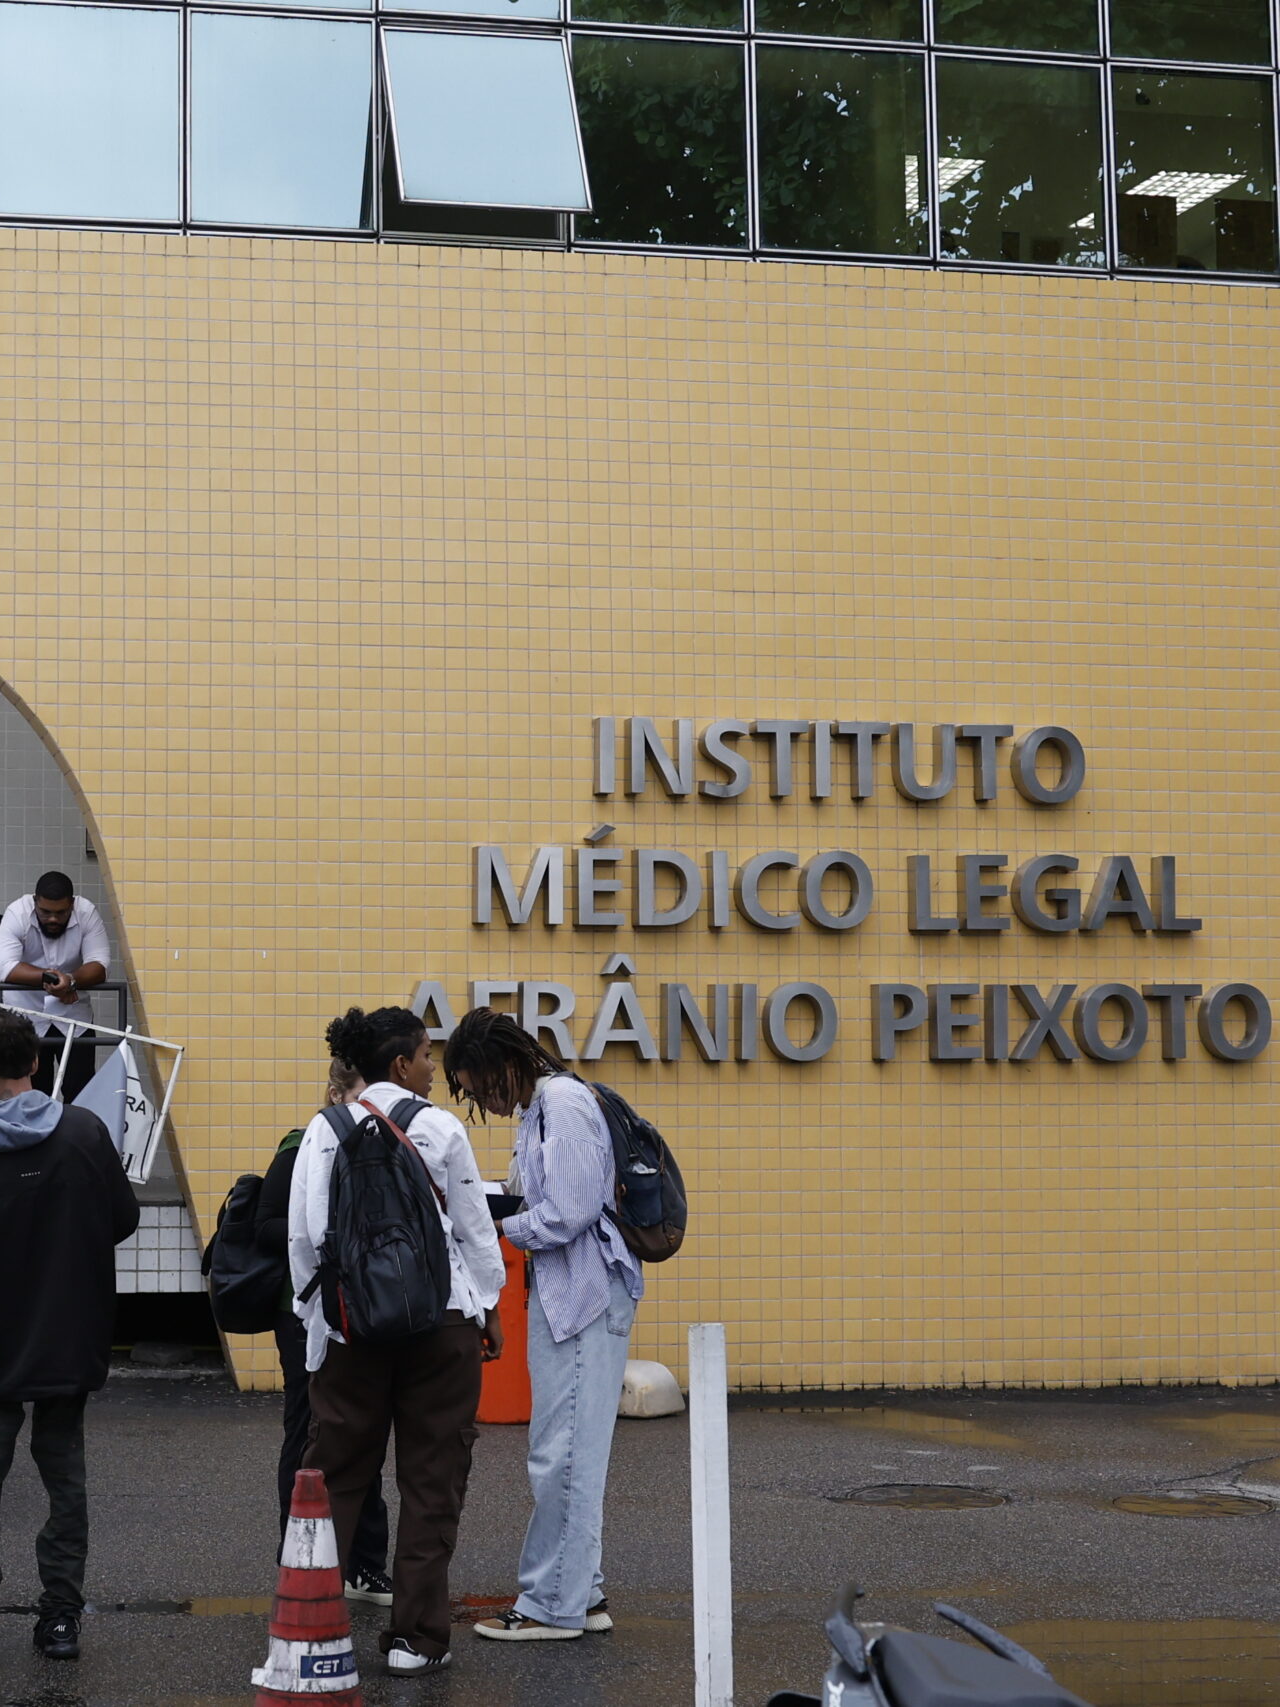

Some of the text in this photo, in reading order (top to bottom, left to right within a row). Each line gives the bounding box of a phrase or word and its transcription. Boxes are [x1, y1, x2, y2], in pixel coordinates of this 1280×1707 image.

[593, 716, 1086, 805] INSTITUTO
[472, 823, 1203, 934] MÉDICO LEGAL
[870, 981, 1273, 1064] PEIXOTO
[312, 1659, 340, 1675] CET
